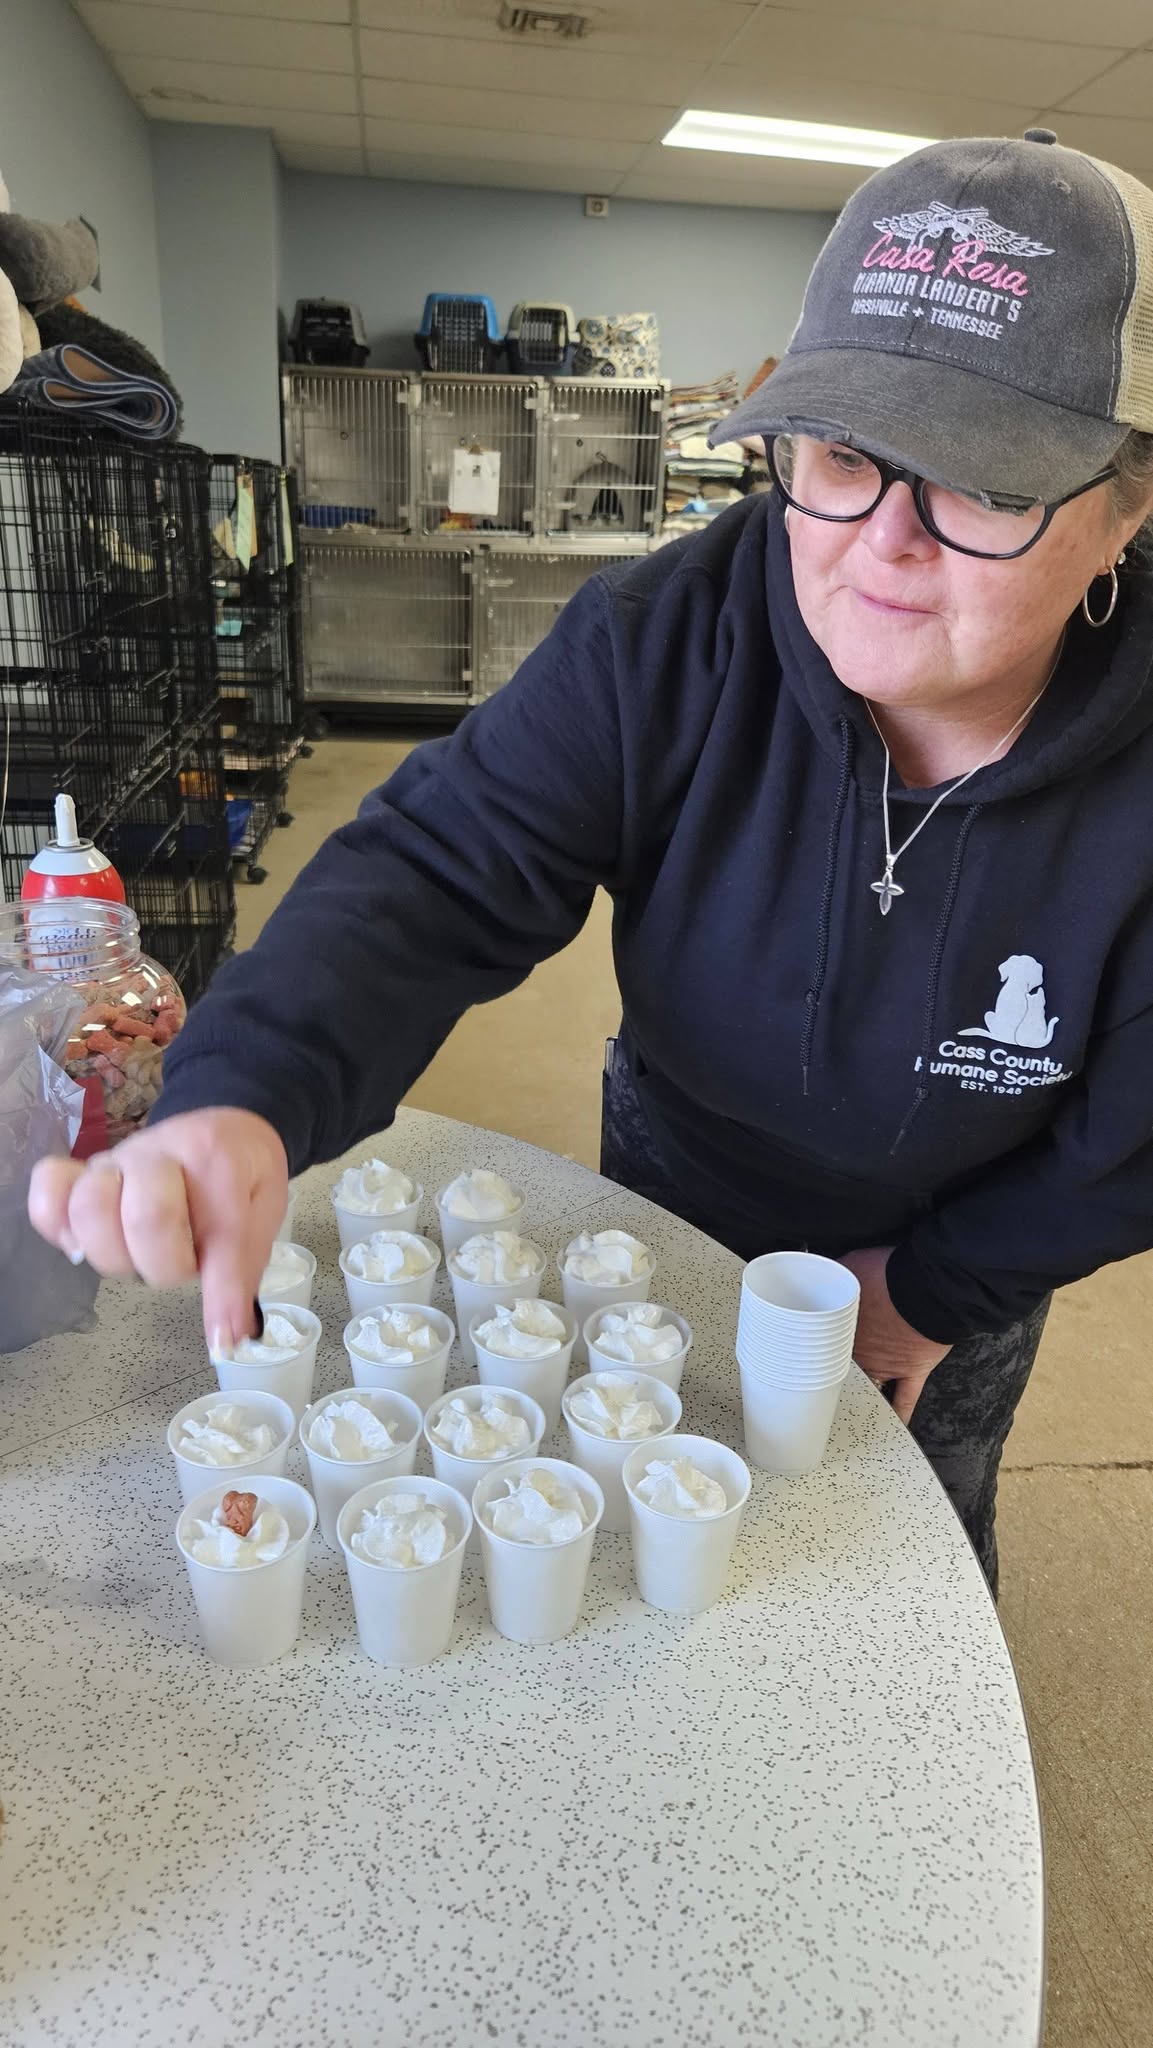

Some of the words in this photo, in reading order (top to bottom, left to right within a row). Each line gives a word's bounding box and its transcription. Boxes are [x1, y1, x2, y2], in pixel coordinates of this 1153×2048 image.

[862, 232, 936, 272] Casa
[942, 240, 1029, 296] Rosa
[853, 271, 919, 297] MIRANDA
[920, 275, 1023, 323] LAMBERT'S
[850, 299, 910, 318] NASHVILLE
[930, 307, 1004, 341] TENNESSEE
[938, 1040, 986, 1061] Cass
[989, 1048, 1063, 1075] County
[960, 1080, 988, 1093] EST.
[993, 1085, 1023, 1095] 1948
[1002, 1069, 1073, 1087] Society
